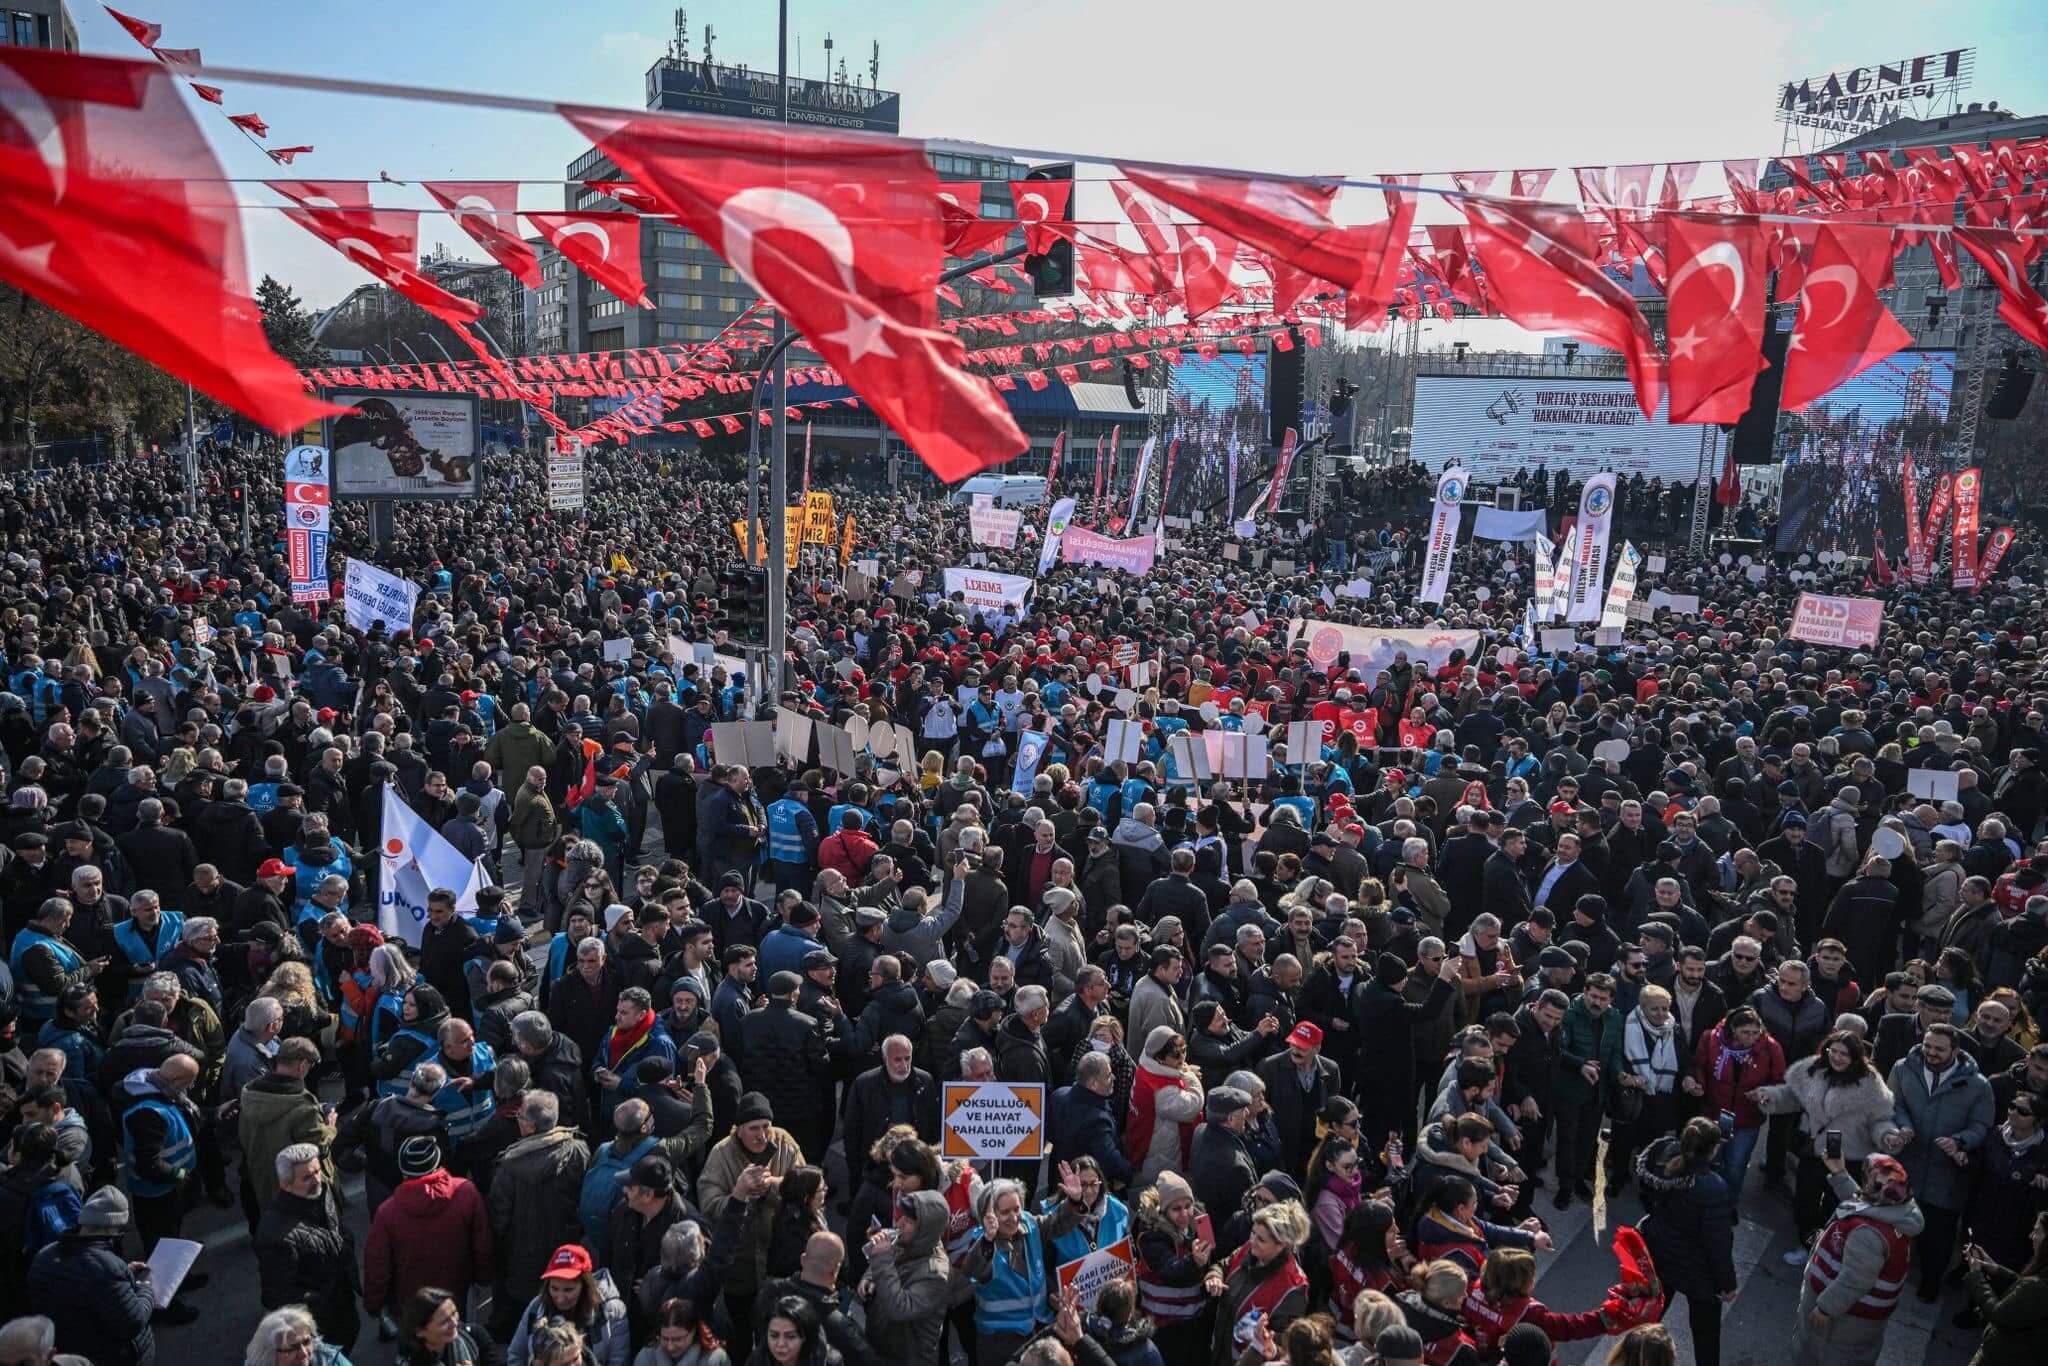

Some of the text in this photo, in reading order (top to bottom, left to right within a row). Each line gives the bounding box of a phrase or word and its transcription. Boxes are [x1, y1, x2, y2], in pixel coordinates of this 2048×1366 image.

[1779, 47, 1968, 110] MAGNET
[752, 105, 777, 117] HOTEL
[837, 117, 865, 129] CENTER
[1536, 391, 1577, 408] YURTTAŞ
[293, 591, 329, 601] GEBZE
[955, 1095, 1032, 1109] YOKSULLUĞA
[966, 1112, 1022, 1121] VE HAYAT
[953, 1123, 1034, 1135] PAHALILIĞINA
[981, 1138, 1006, 1148] SON
